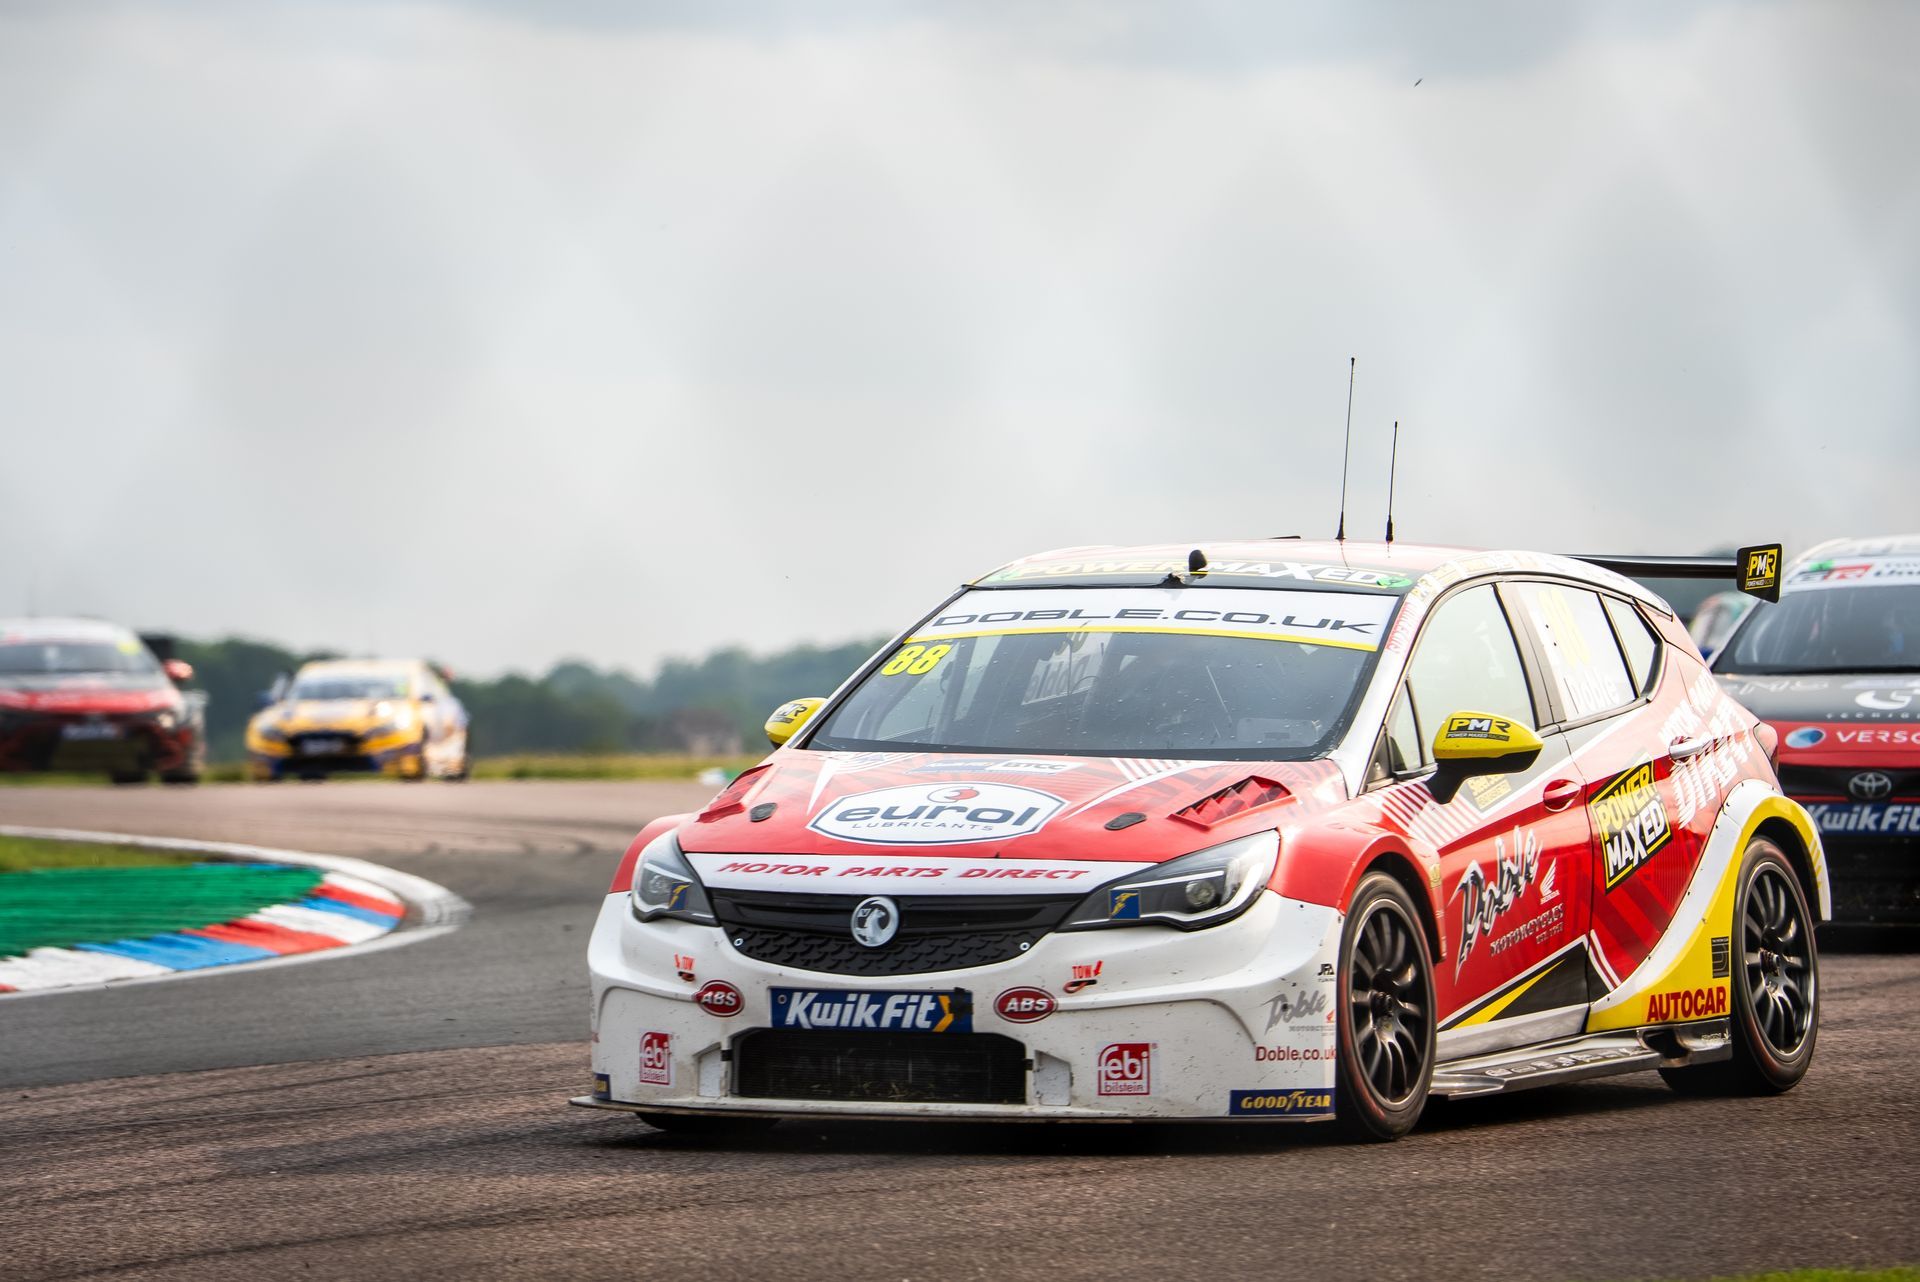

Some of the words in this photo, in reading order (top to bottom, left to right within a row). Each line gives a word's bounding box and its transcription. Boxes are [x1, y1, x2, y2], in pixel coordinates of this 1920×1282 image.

[1749, 554, 1775, 577] PMR
[932, 608, 1379, 634] DOBLE.CO.UK
[881, 645, 951, 676] 88
[1449, 719, 1511, 733] PMR
[1596, 765, 1656, 841] POWER
[835, 805, 1040, 827] eurol
[852, 822, 994, 831] LUBRICANTS
[1605, 800, 1666, 877] MAXED
[716, 862, 830, 876] MOTOR
[837, 867, 947, 877] PARTS
[958, 868, 1090, 880] DIRECT
[1489, 903, 1564, 956] MOTORCYCLES
[1072, 964, 1094, 979] TOW
[701, 991, 737, 1007] ABS
[1004, 997, 1049, 1013] ABS
[1646, 986, 1727, 1022] AUTOCAR
[1256, 990, 1327, 1035] Doble
[1097, 1046, 1149, 1080] febi
[1104, 1081, 1144, 1093] bilstein
[1240, 1091, 1332, 1112] GOODYEAR
